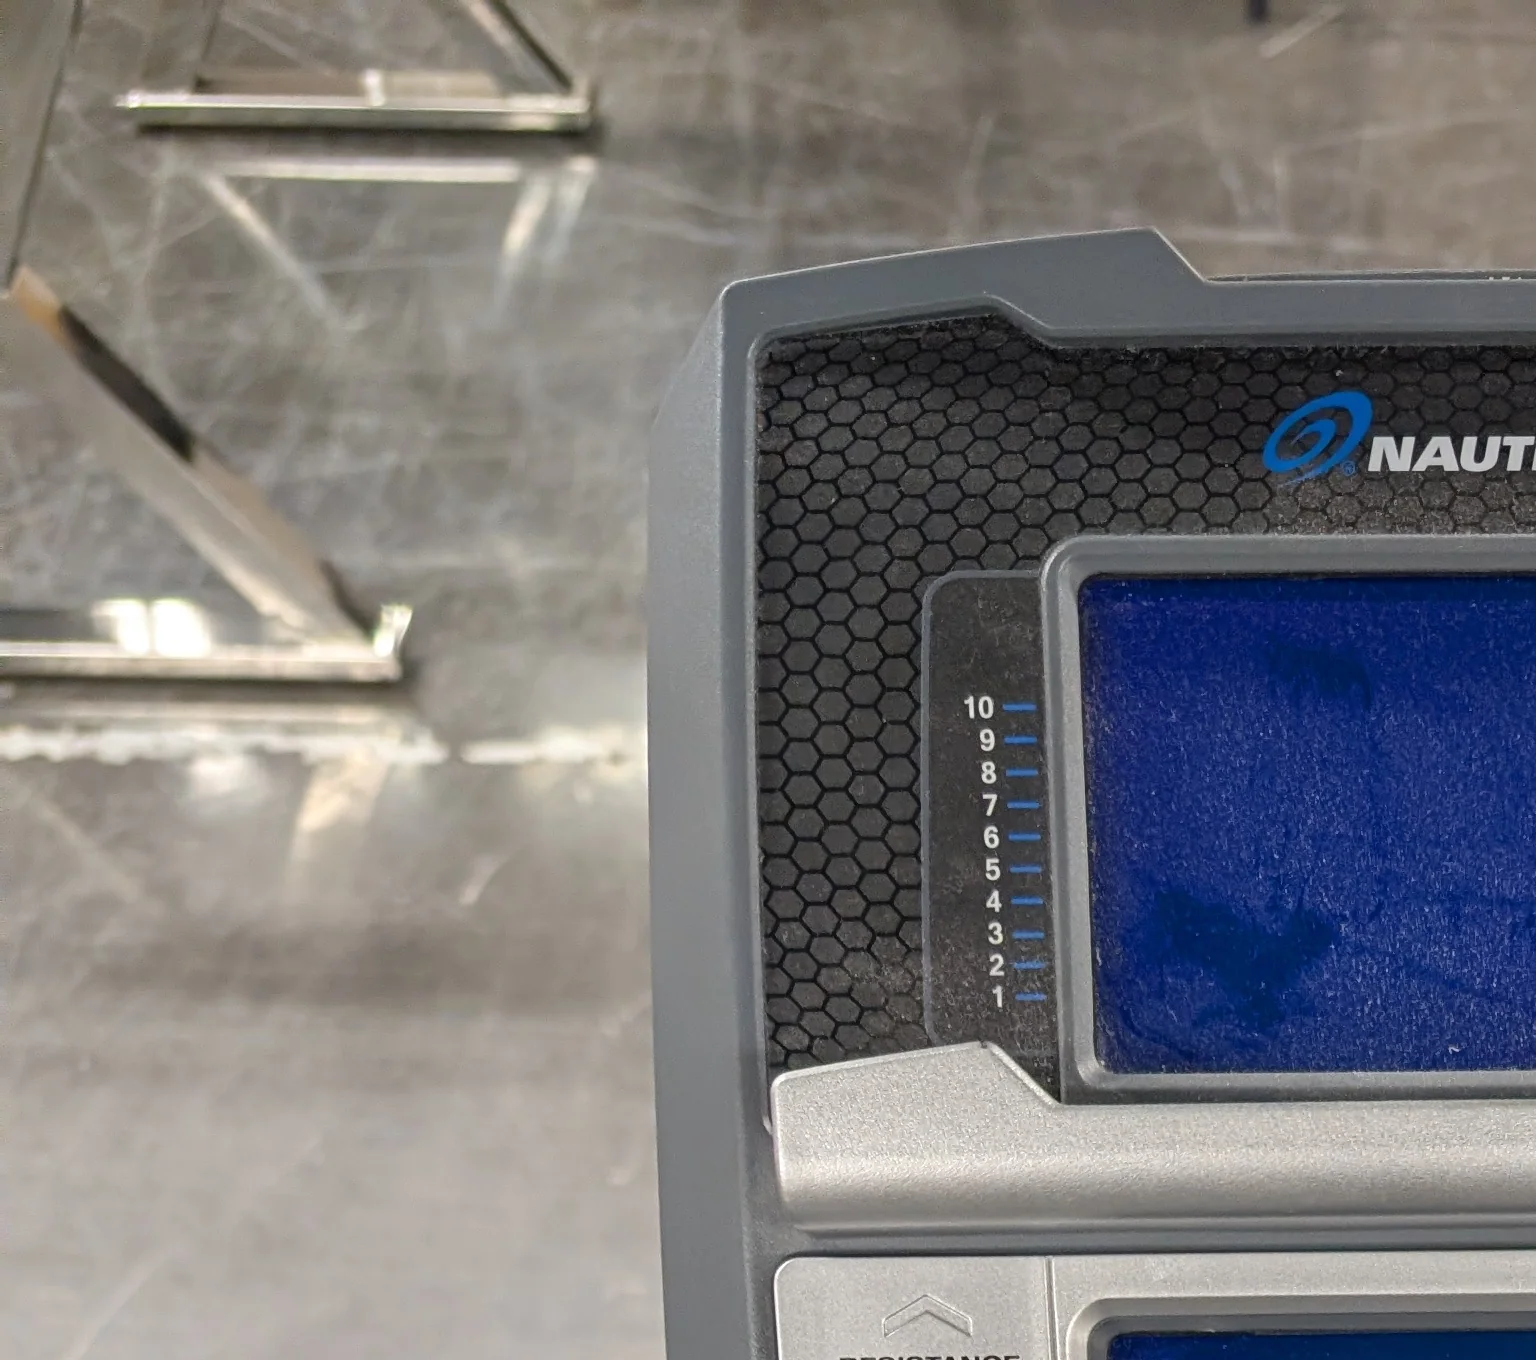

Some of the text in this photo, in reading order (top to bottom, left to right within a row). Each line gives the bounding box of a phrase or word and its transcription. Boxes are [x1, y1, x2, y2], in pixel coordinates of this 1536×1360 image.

[963, 695, 994, 719] 10
[979, 728, 996, 752] 9
[981, 761, 997, 784] 8
[982, 793, 998, 817] 7
[983, 825, 1000, 849] 6
[985, 857, 1001, 881] 5
[985, 889, 1002, 913] 4
[988, 921, 1004, 945] 3
[989, 953, 1005, 977] 2
[992, 985, 1003, 1008] 1
